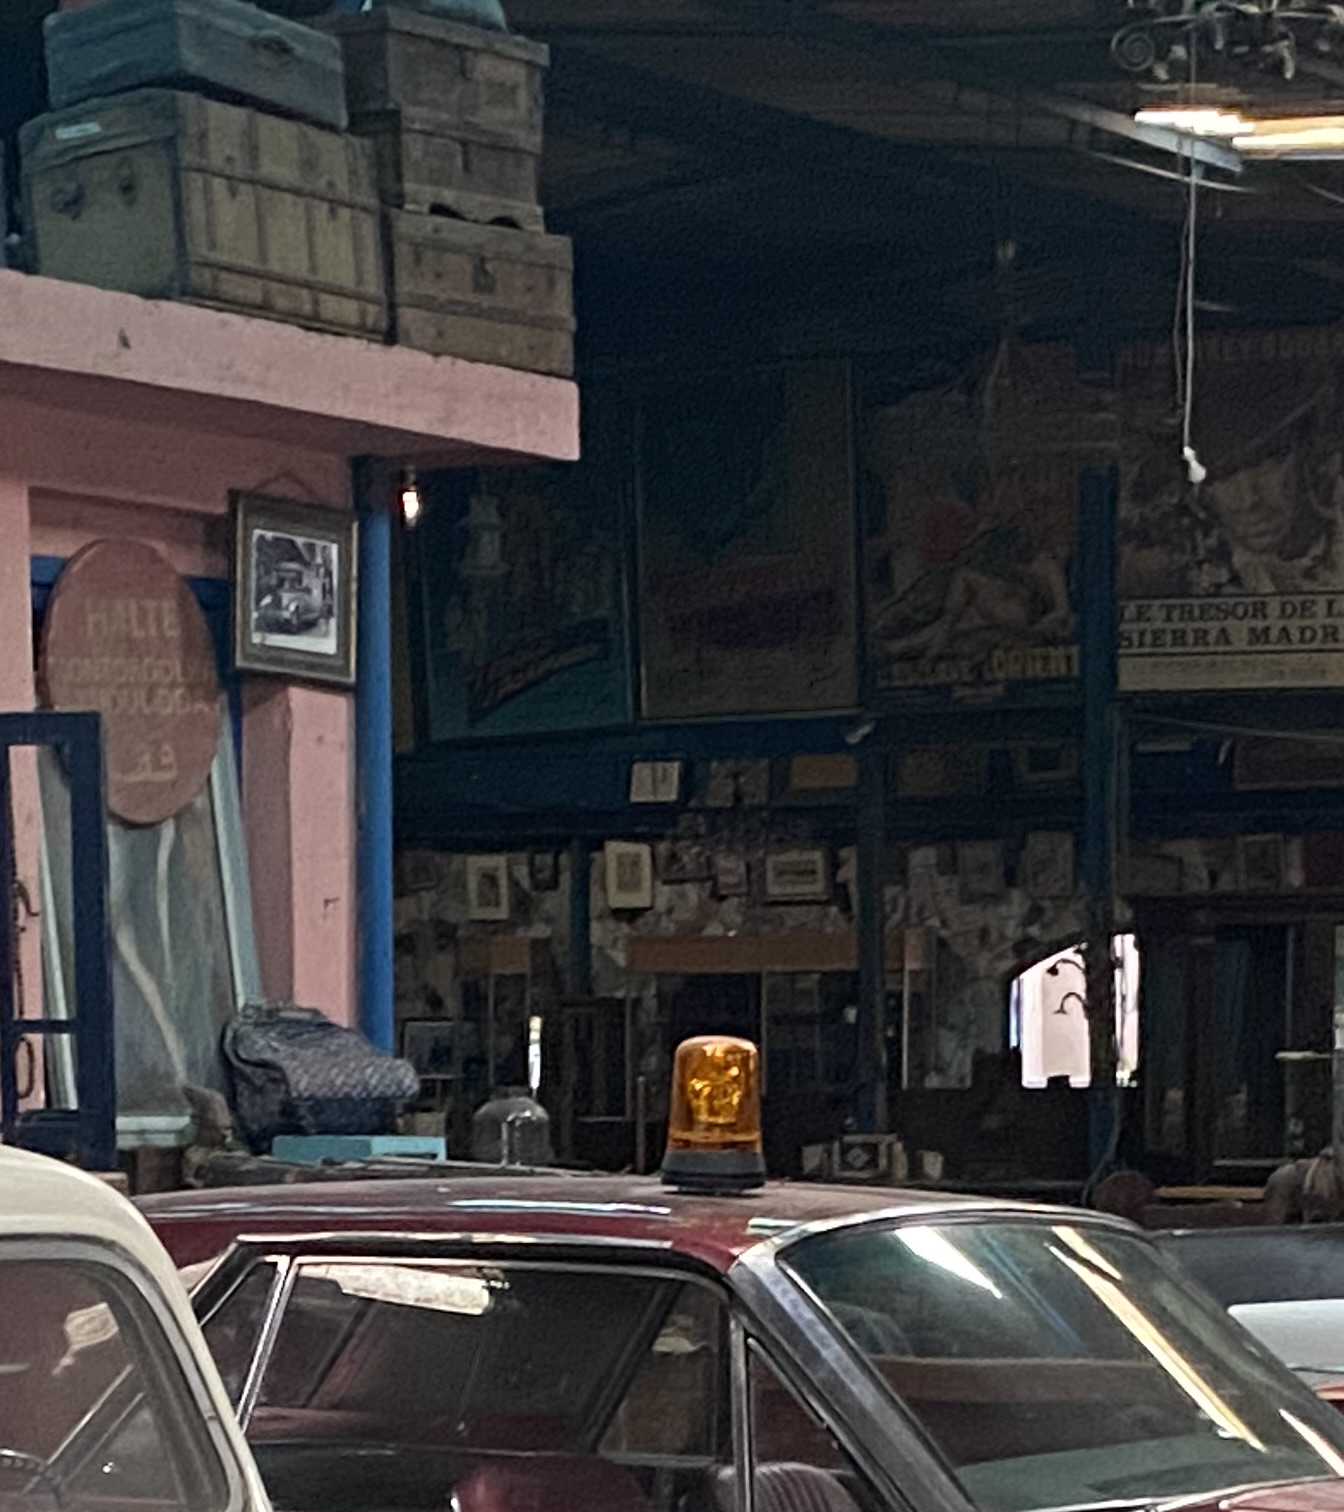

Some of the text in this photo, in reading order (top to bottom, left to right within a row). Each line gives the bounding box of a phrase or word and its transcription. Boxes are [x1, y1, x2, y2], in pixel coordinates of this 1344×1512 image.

[85, 598, 182, 638] HALTE
[1118, 603, 1152, 624] LE
[1158, 600, 1269, 623] TRESOR
[1278, 598, 1317, 619] DE
[1118, 627, 1233, 649] SIERRA
